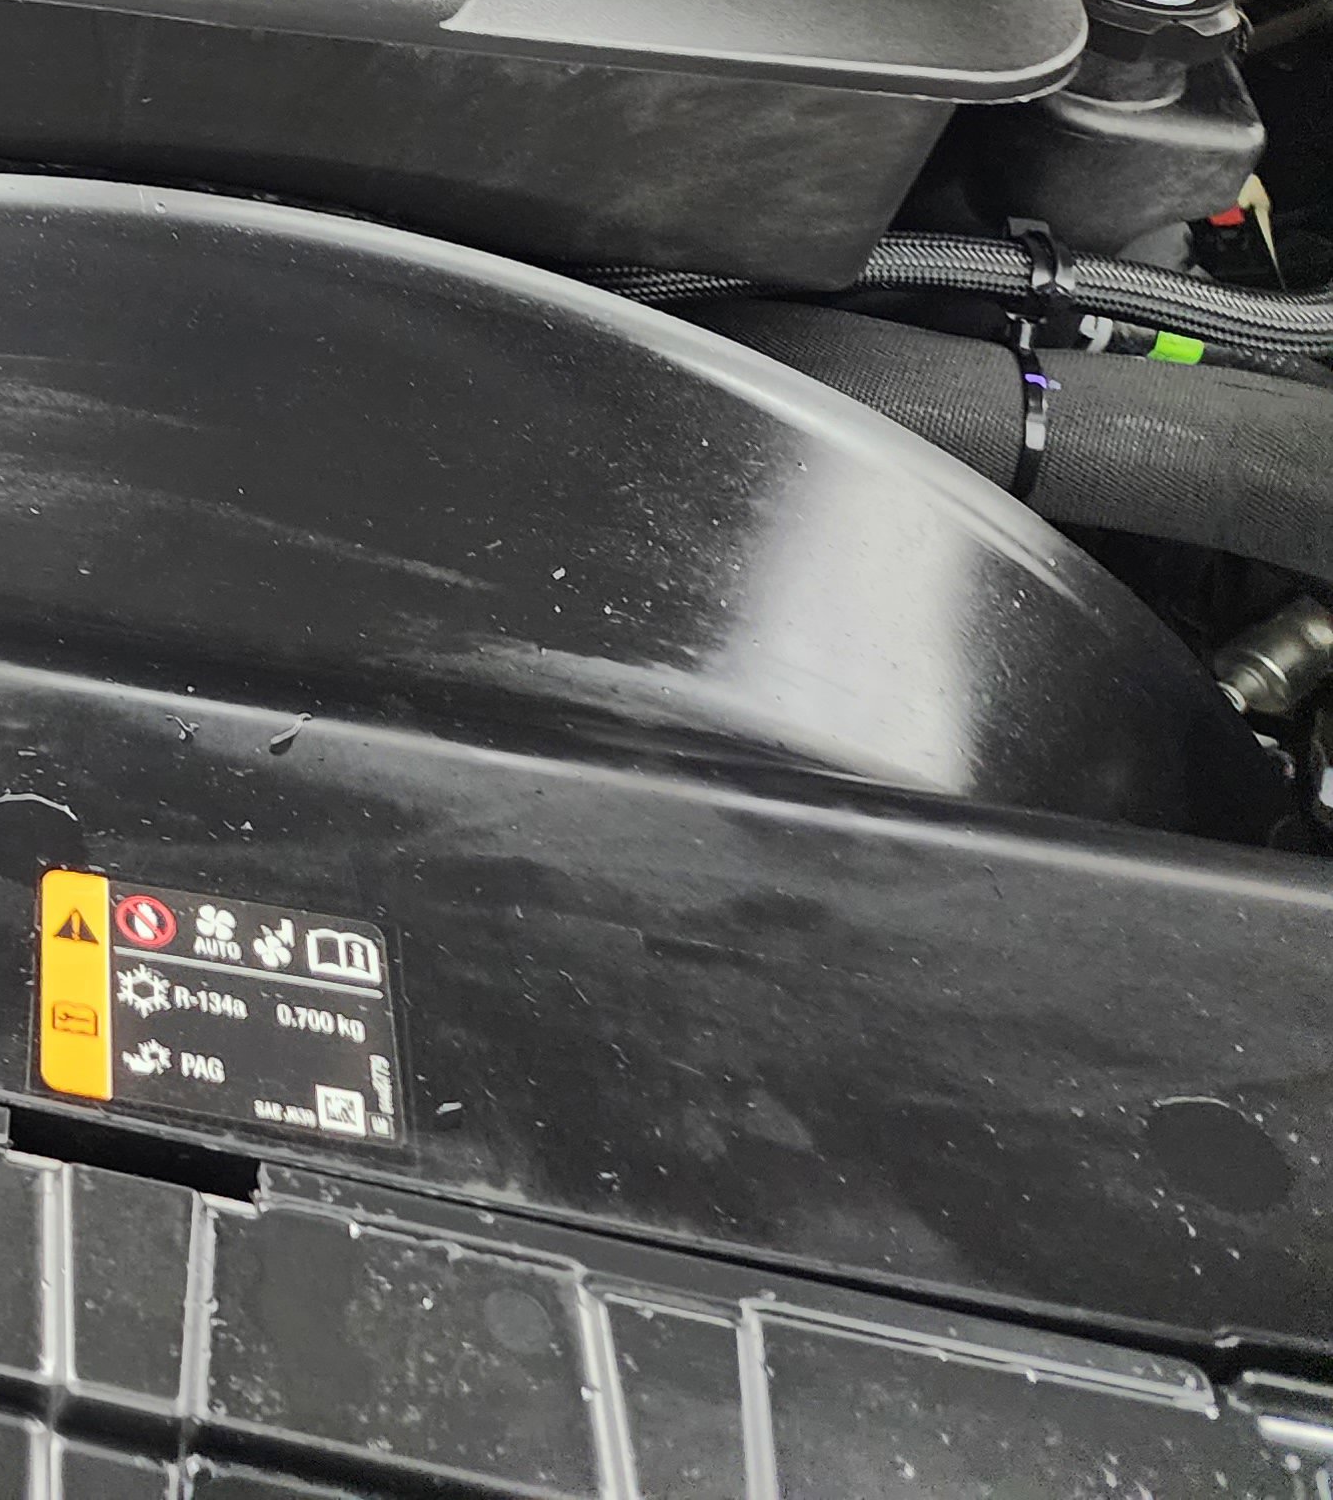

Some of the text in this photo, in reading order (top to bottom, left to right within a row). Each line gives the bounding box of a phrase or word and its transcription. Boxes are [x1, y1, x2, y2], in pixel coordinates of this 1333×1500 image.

[193, 936, 242, 960] AUTO
[174, 985, 366, 1044] R-134a 0.700 kg
[181, 1052, 226, 1083] PAG
